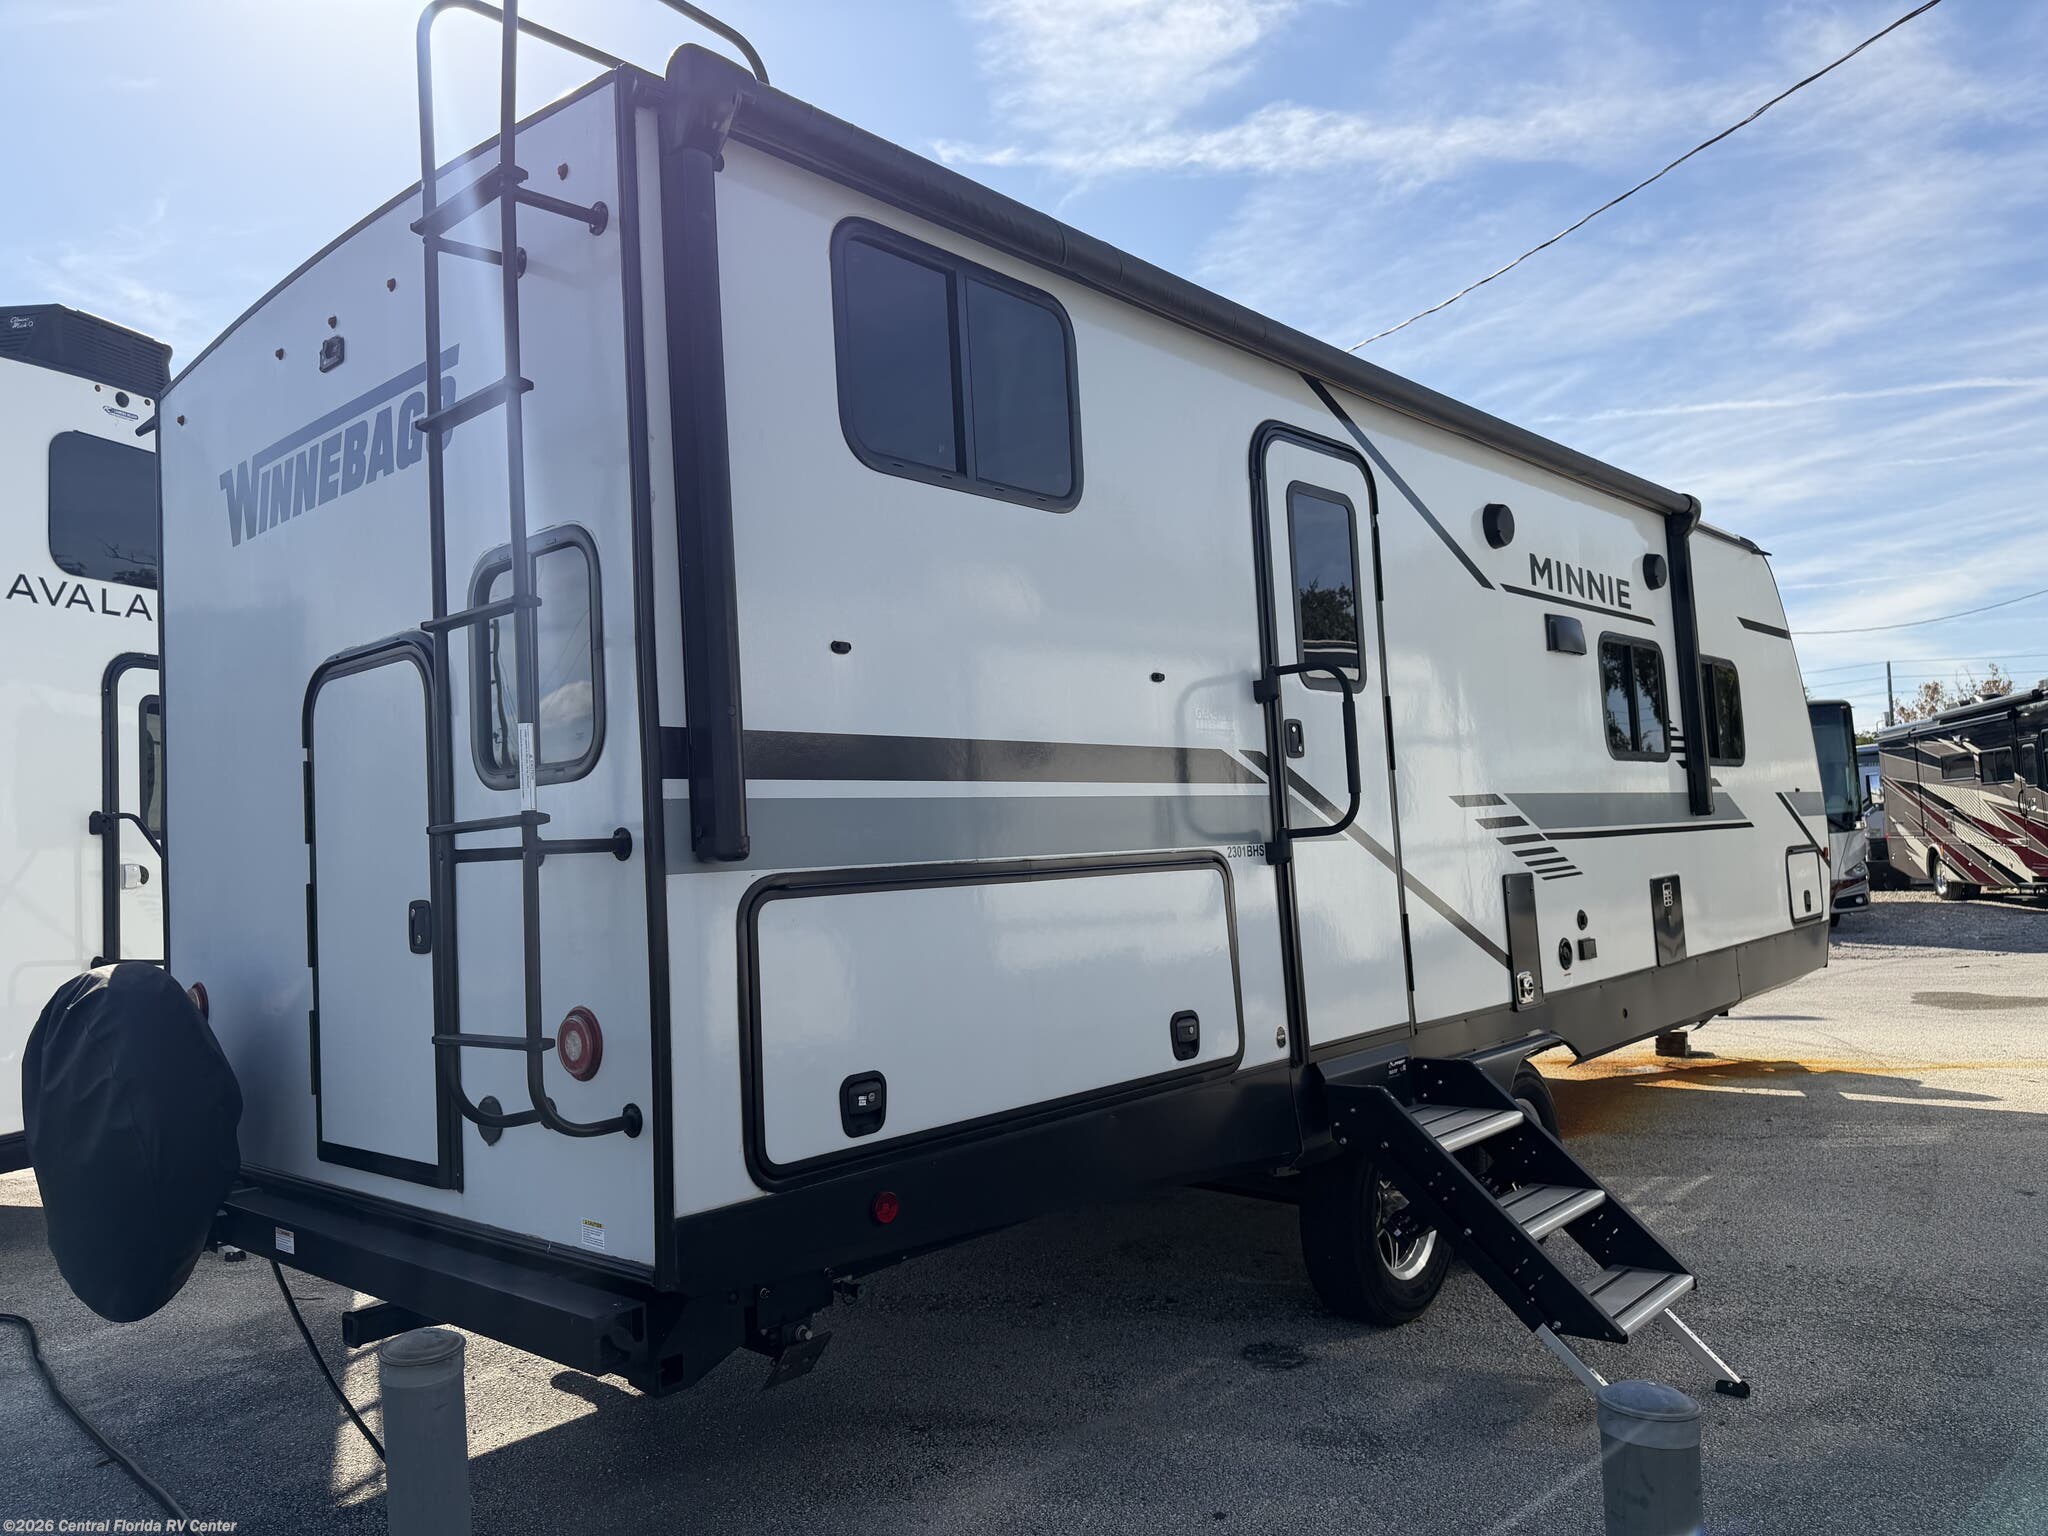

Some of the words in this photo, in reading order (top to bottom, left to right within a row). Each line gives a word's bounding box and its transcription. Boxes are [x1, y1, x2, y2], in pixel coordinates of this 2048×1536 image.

[6, 573, 153, 622] AVALA
[1529, 552, 1632, 610] MINNIE
[1227, 844, 1265, 859] 2301BHS
